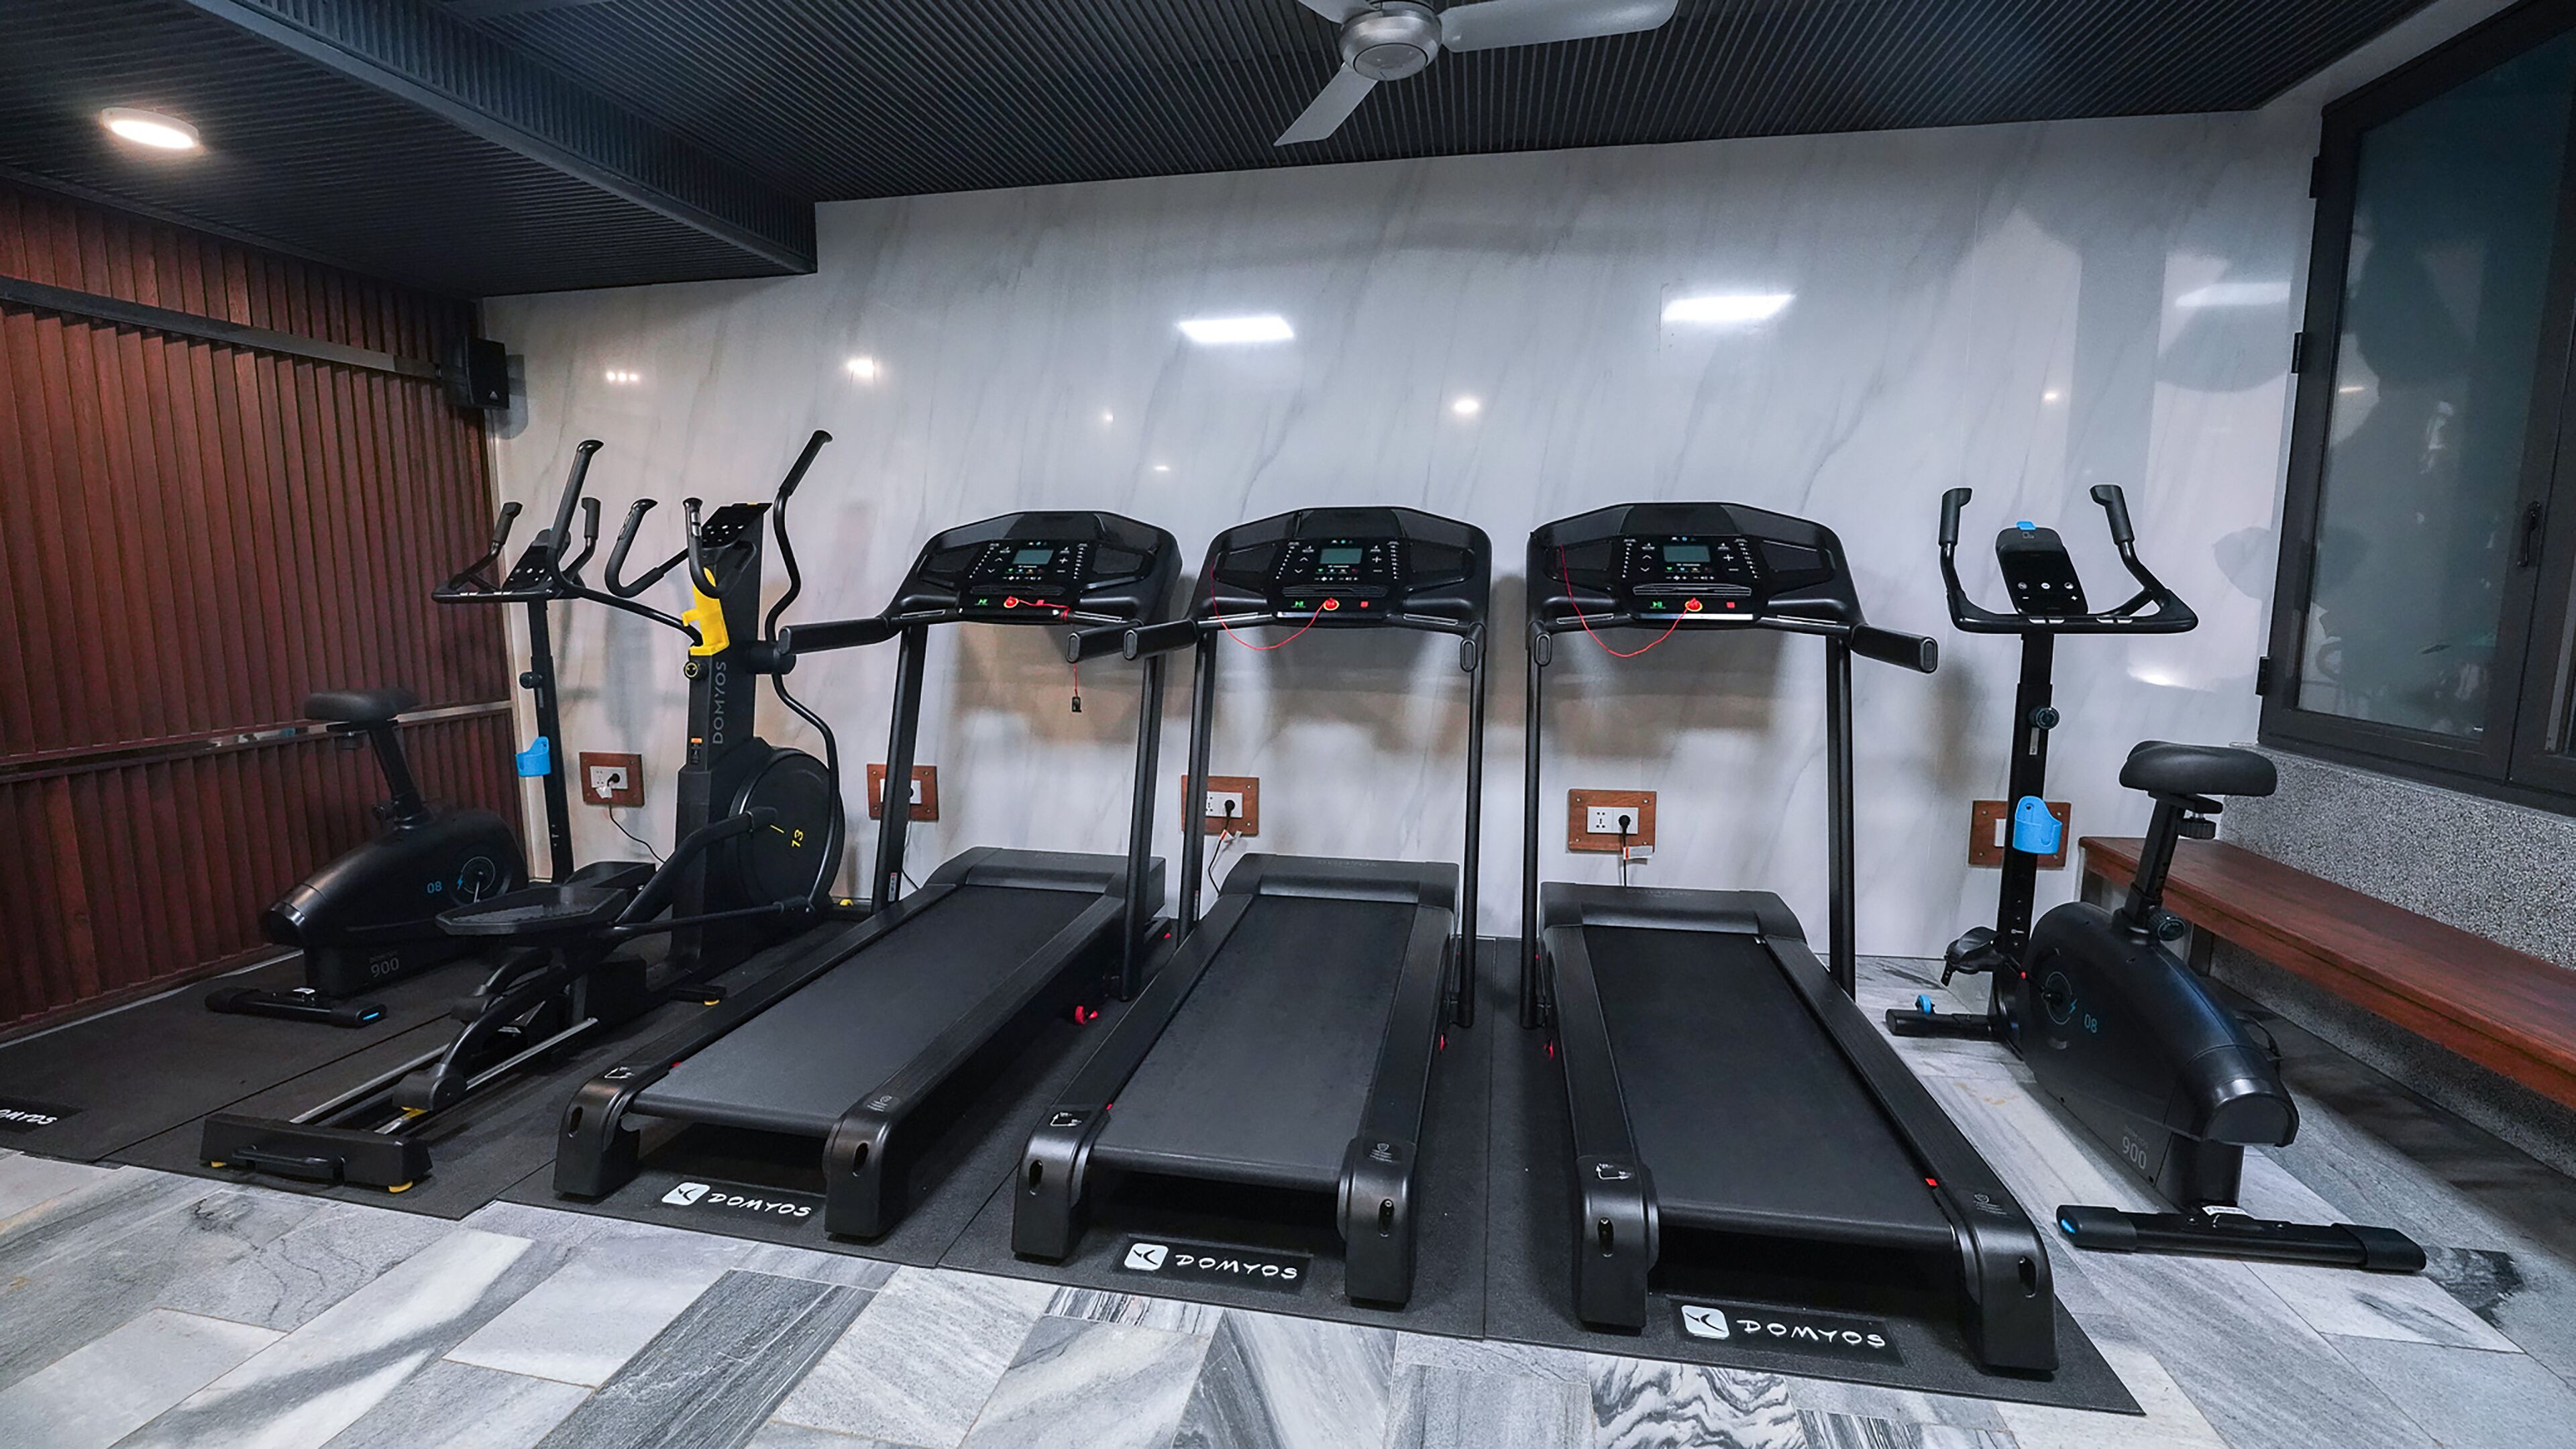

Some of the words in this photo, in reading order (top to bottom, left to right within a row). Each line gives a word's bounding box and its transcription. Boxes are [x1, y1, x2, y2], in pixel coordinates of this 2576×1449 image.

[712, 661, 727, 744] DOMYOS
[792, 829, 804, 847] 13
[427, 881, 442, 894] 08
[370, 957, 399, 978] 900
[2084, 1014, 2098, 1033] 08
[2123, 1136, 2147, 1171] 900
[708, 1193, 812, 1217] DOMYOS
[1175, 1254, 1298, 1279] DOMYOS
[1737, 1320, 1886, 1348] DOMYOS
